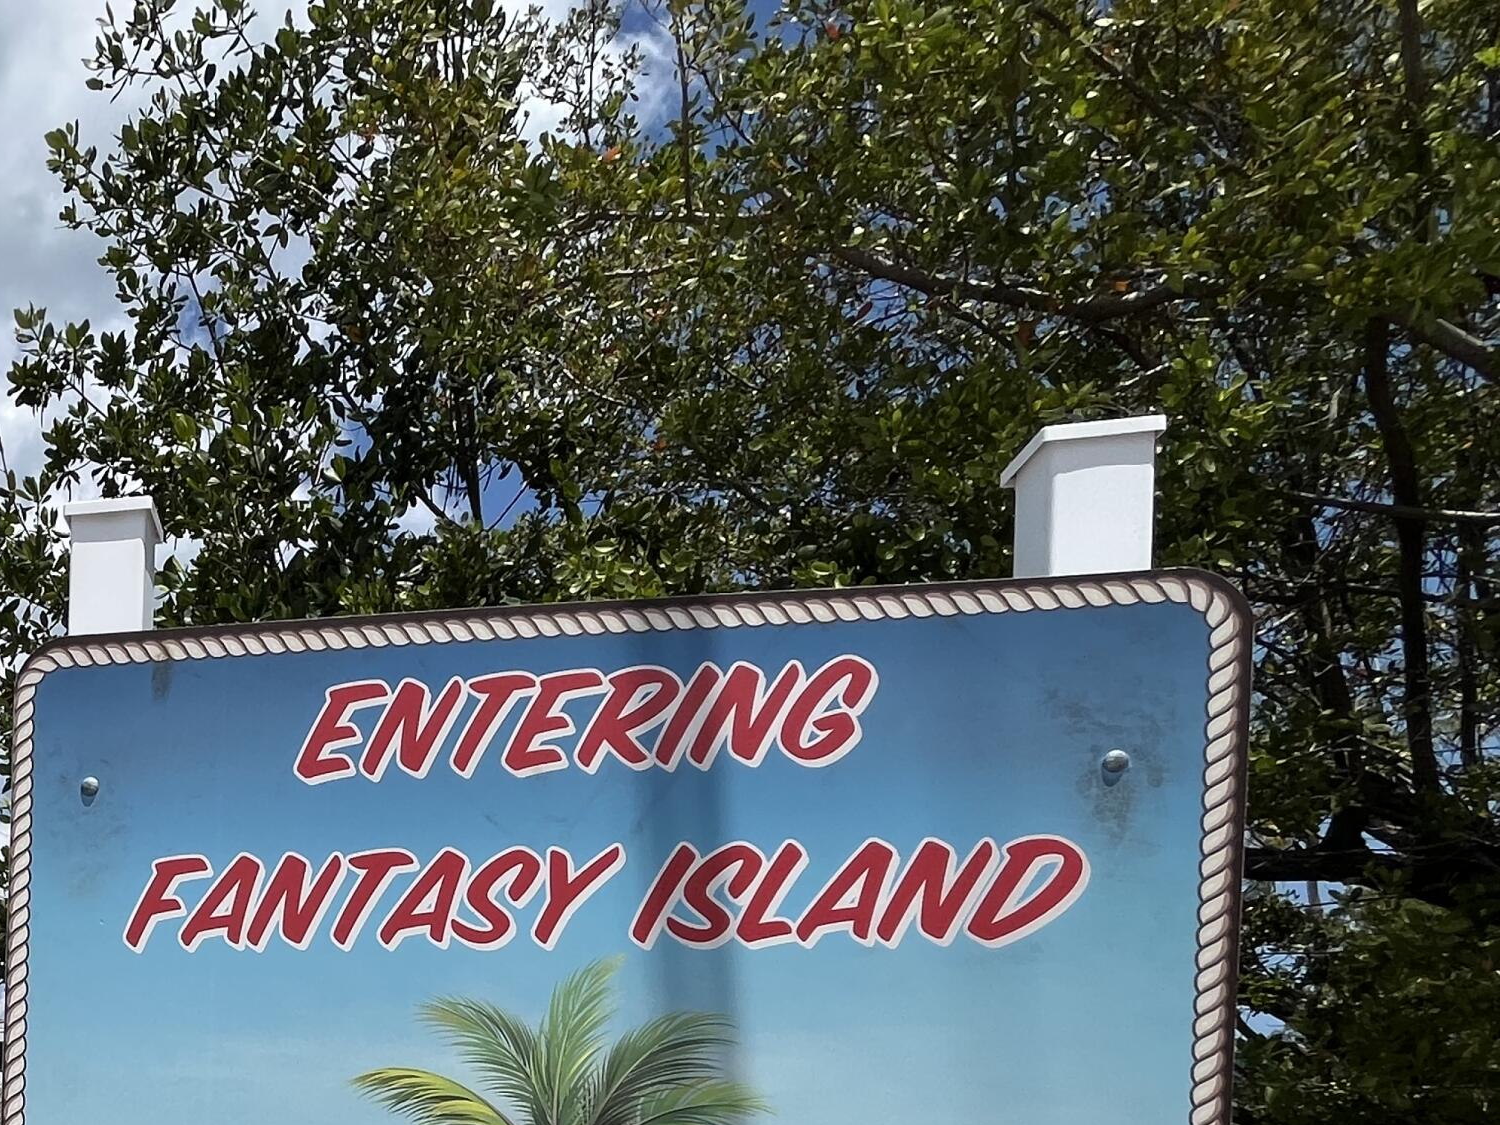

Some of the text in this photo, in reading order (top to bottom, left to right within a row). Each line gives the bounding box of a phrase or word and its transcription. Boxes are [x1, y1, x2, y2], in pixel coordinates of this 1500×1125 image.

[295, 657, 876, 781] ENTERING
[125, 836, 1087, 948] FANTASY ISLAND
